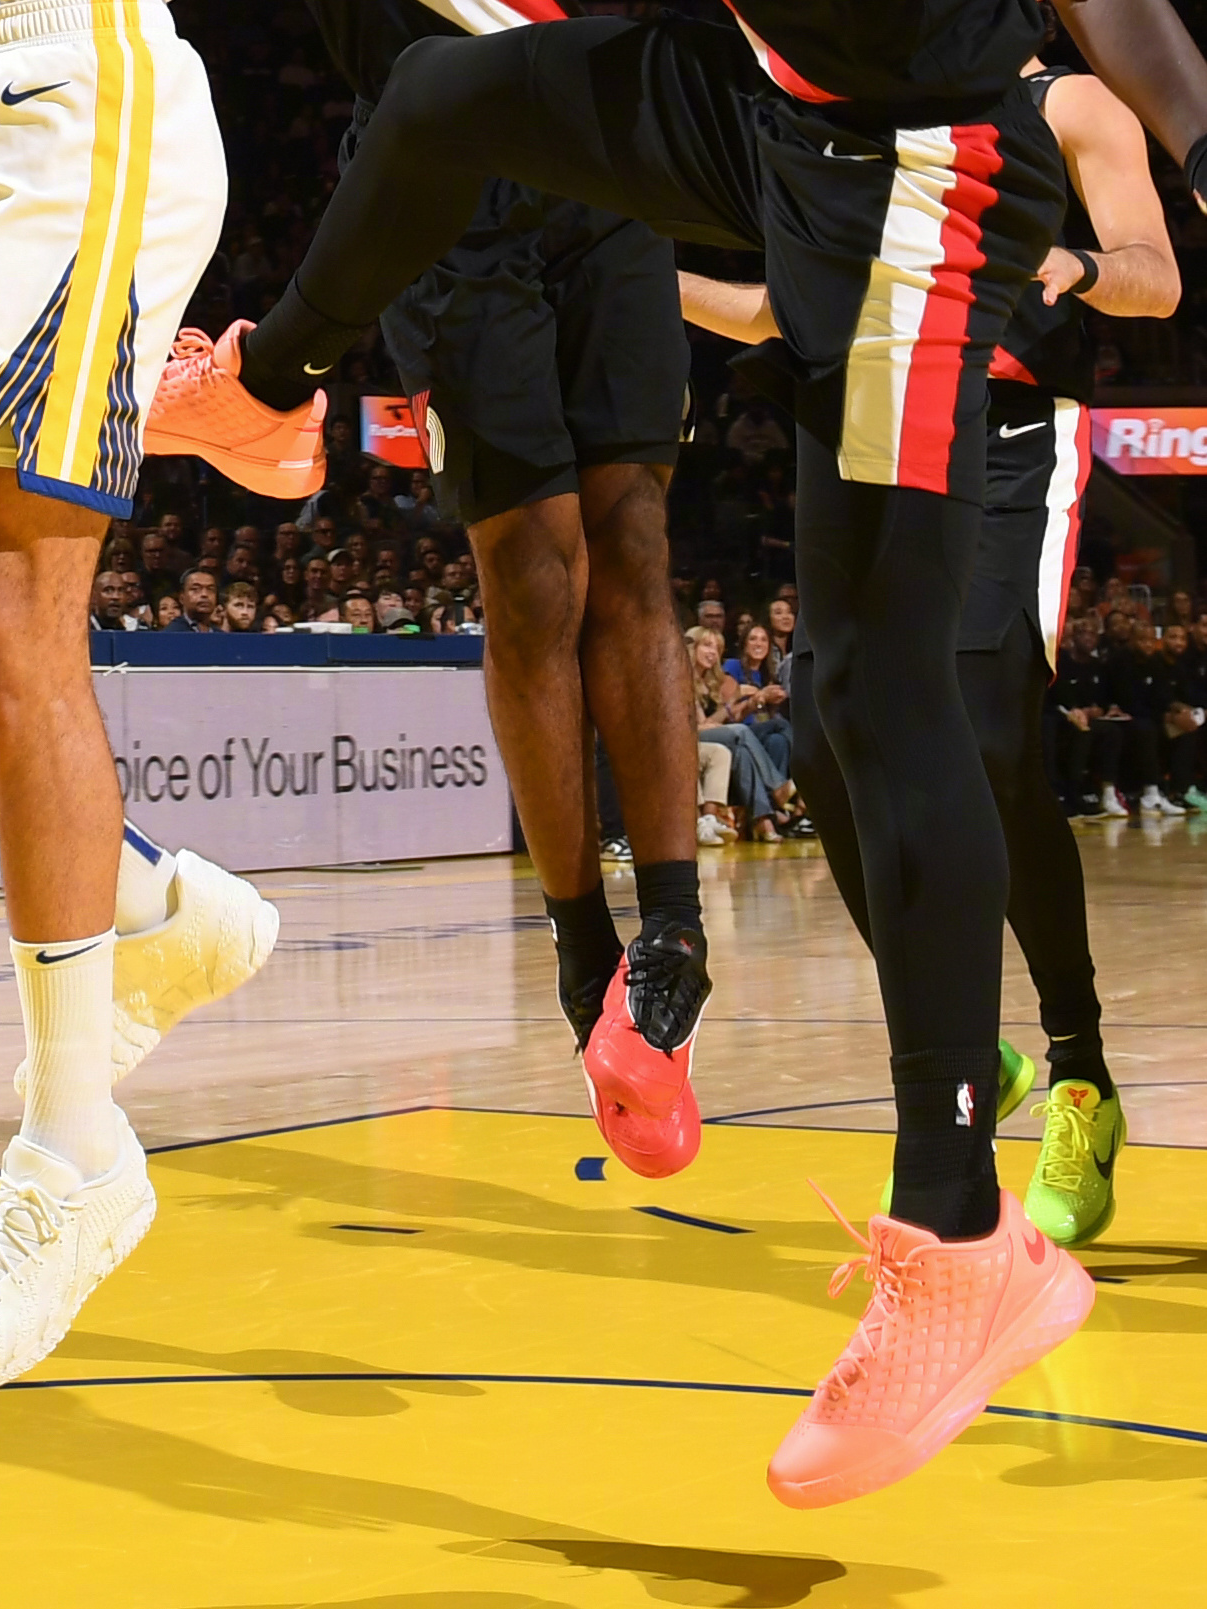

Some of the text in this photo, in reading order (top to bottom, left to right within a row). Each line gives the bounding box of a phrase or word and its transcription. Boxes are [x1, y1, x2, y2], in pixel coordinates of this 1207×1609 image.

[198, 736, 236, 802] of
[241, 735, 327, 799] Your
[331, 731, 489, 795] Business
